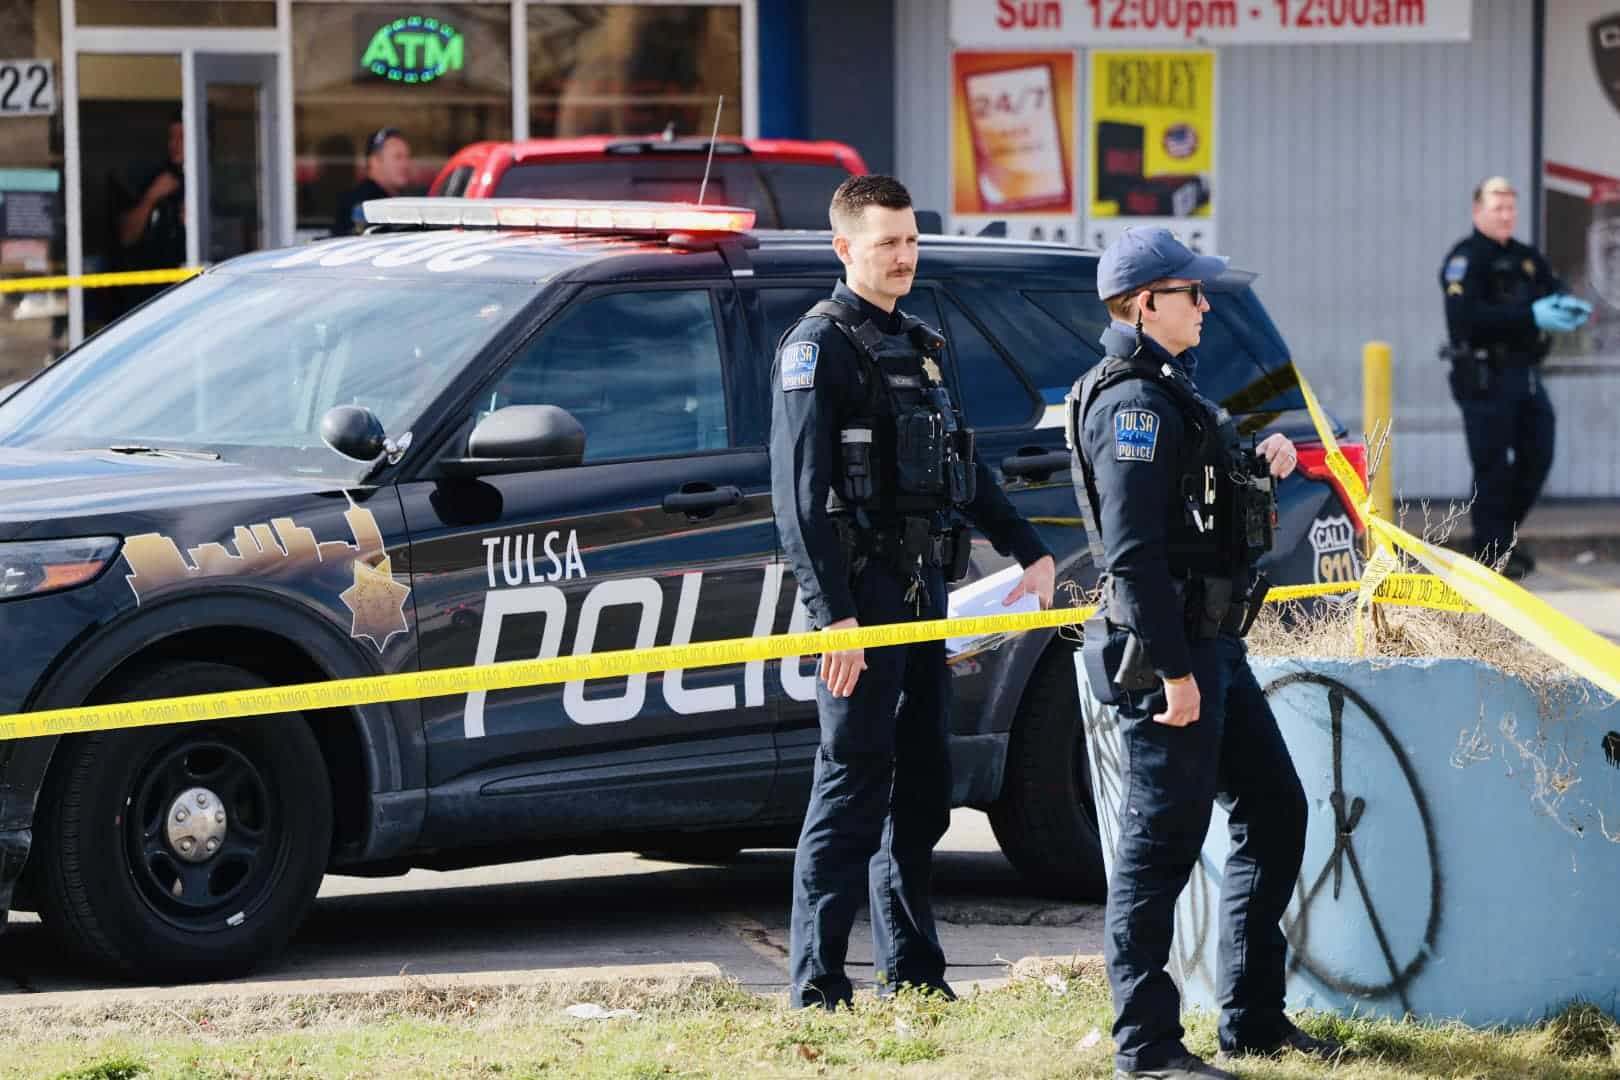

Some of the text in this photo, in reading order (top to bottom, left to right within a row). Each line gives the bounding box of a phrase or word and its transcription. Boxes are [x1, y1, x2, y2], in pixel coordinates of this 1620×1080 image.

[996, 0, 1062, 29] Sun
[1090, 0, 1237, 37] 12:00pm
[1276, 0, 1425, 27] 12:00am
[361, 30, 464, 71] ATM
[784, 344, 813, 361] ULSA
[1119, 412, 1154, 432] TULSA
[1119, 444, 1152, 459] POLICE
[1316, 522, 1349, 547] CALL
[481, 529, 588, 588] TULSA
[1320, 551, 1352, 584] 911
[464, 563, 820, 739] POLI
